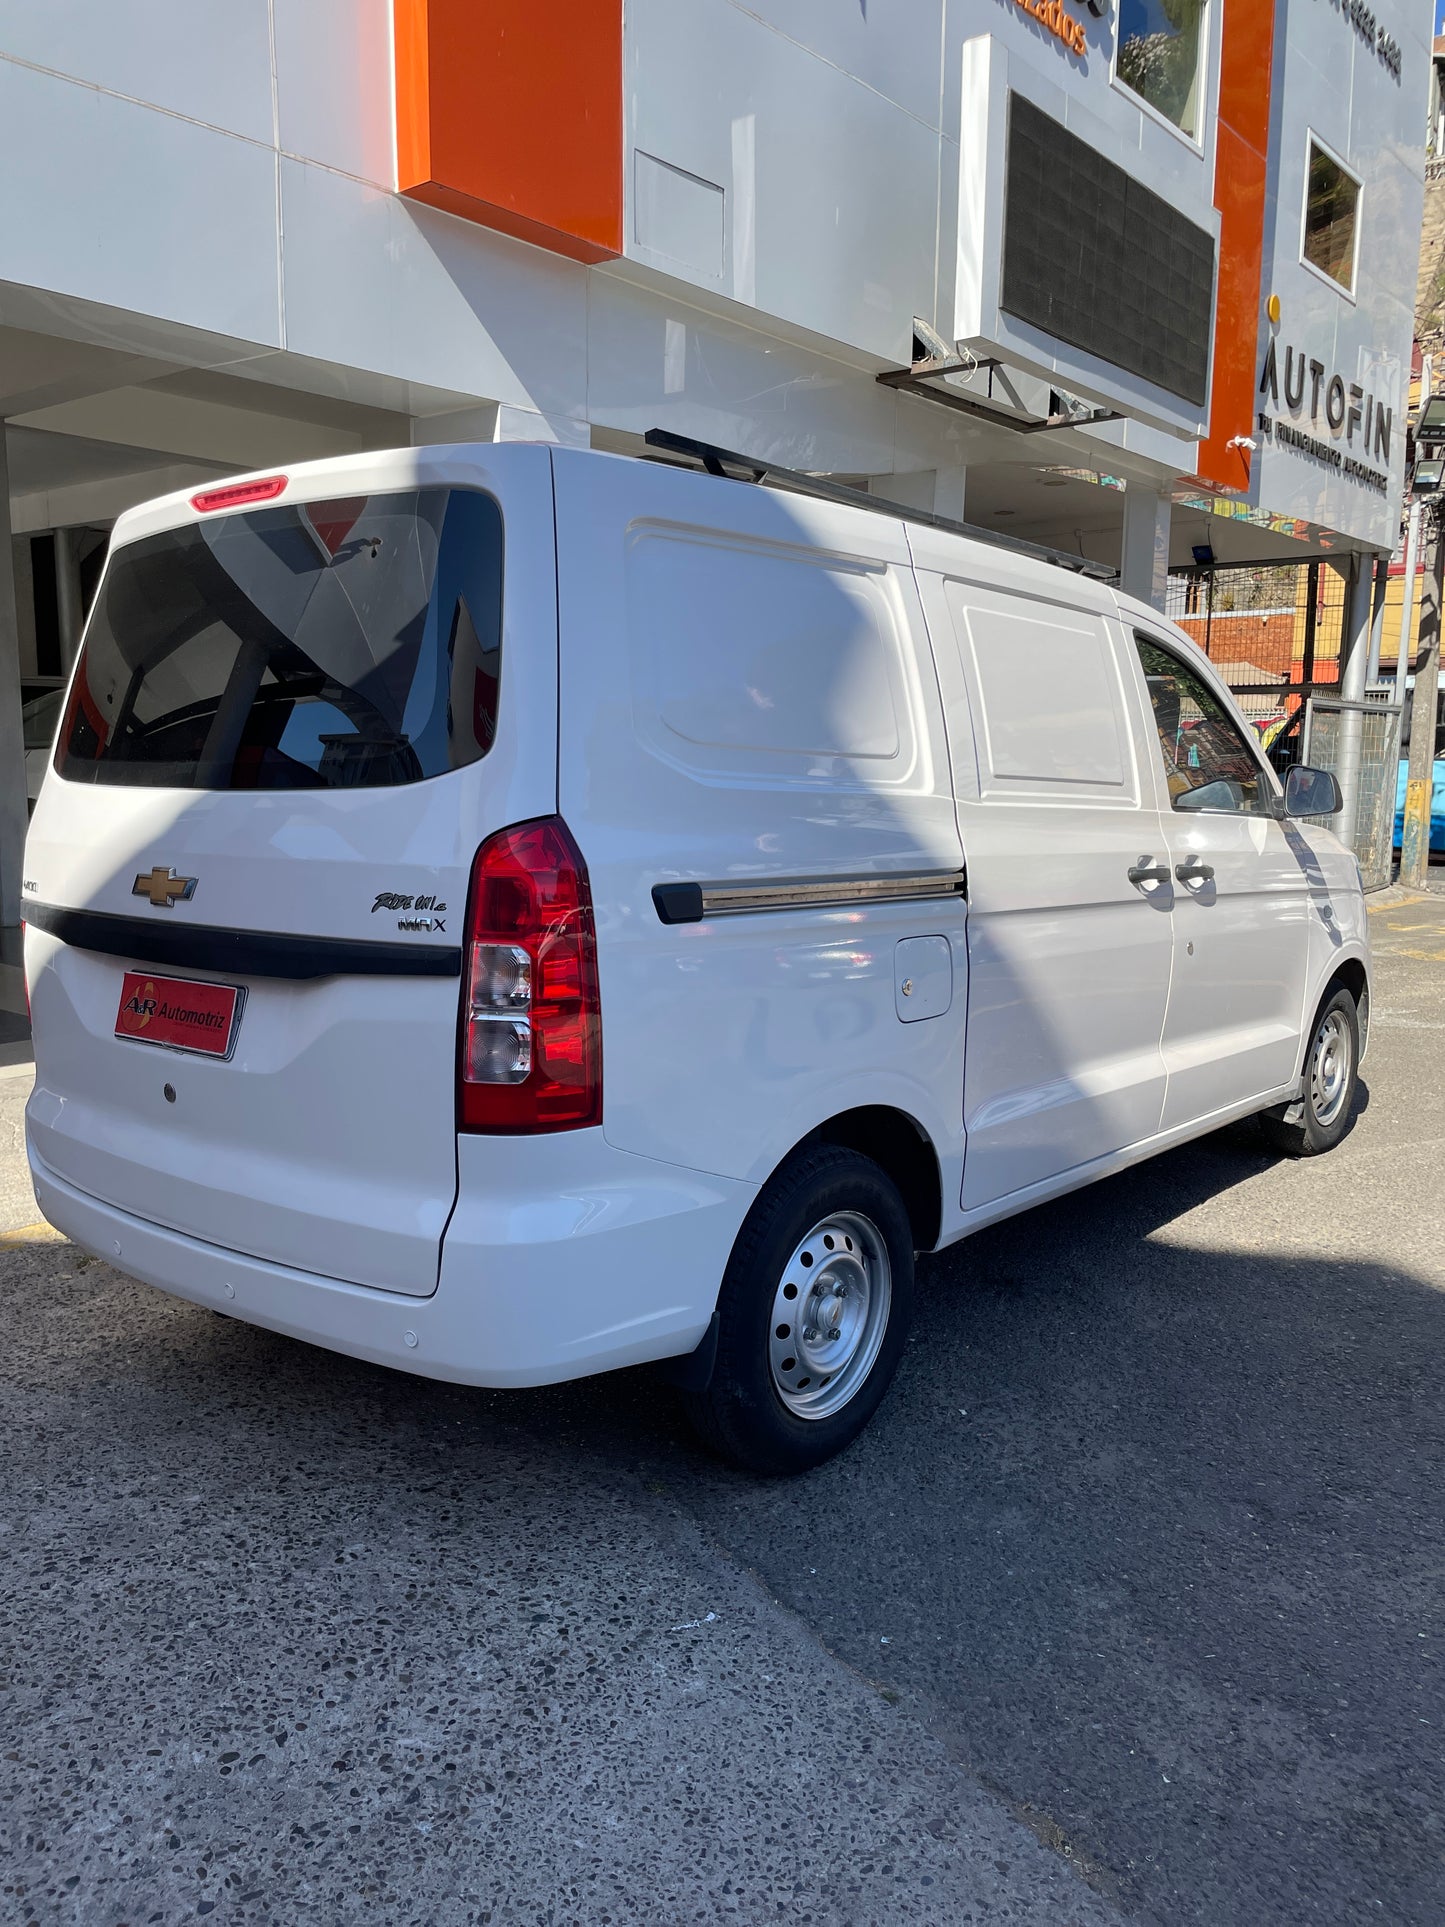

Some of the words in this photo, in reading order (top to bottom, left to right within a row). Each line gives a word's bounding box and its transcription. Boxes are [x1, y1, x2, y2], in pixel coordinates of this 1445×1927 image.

[1260, 336, 1392, 458] AUTOFIN
[1259, 413, 1272, 433] TU
[398, 917, 446, 932] MAX
[158, 1002, 225, 1029] Automotriz
